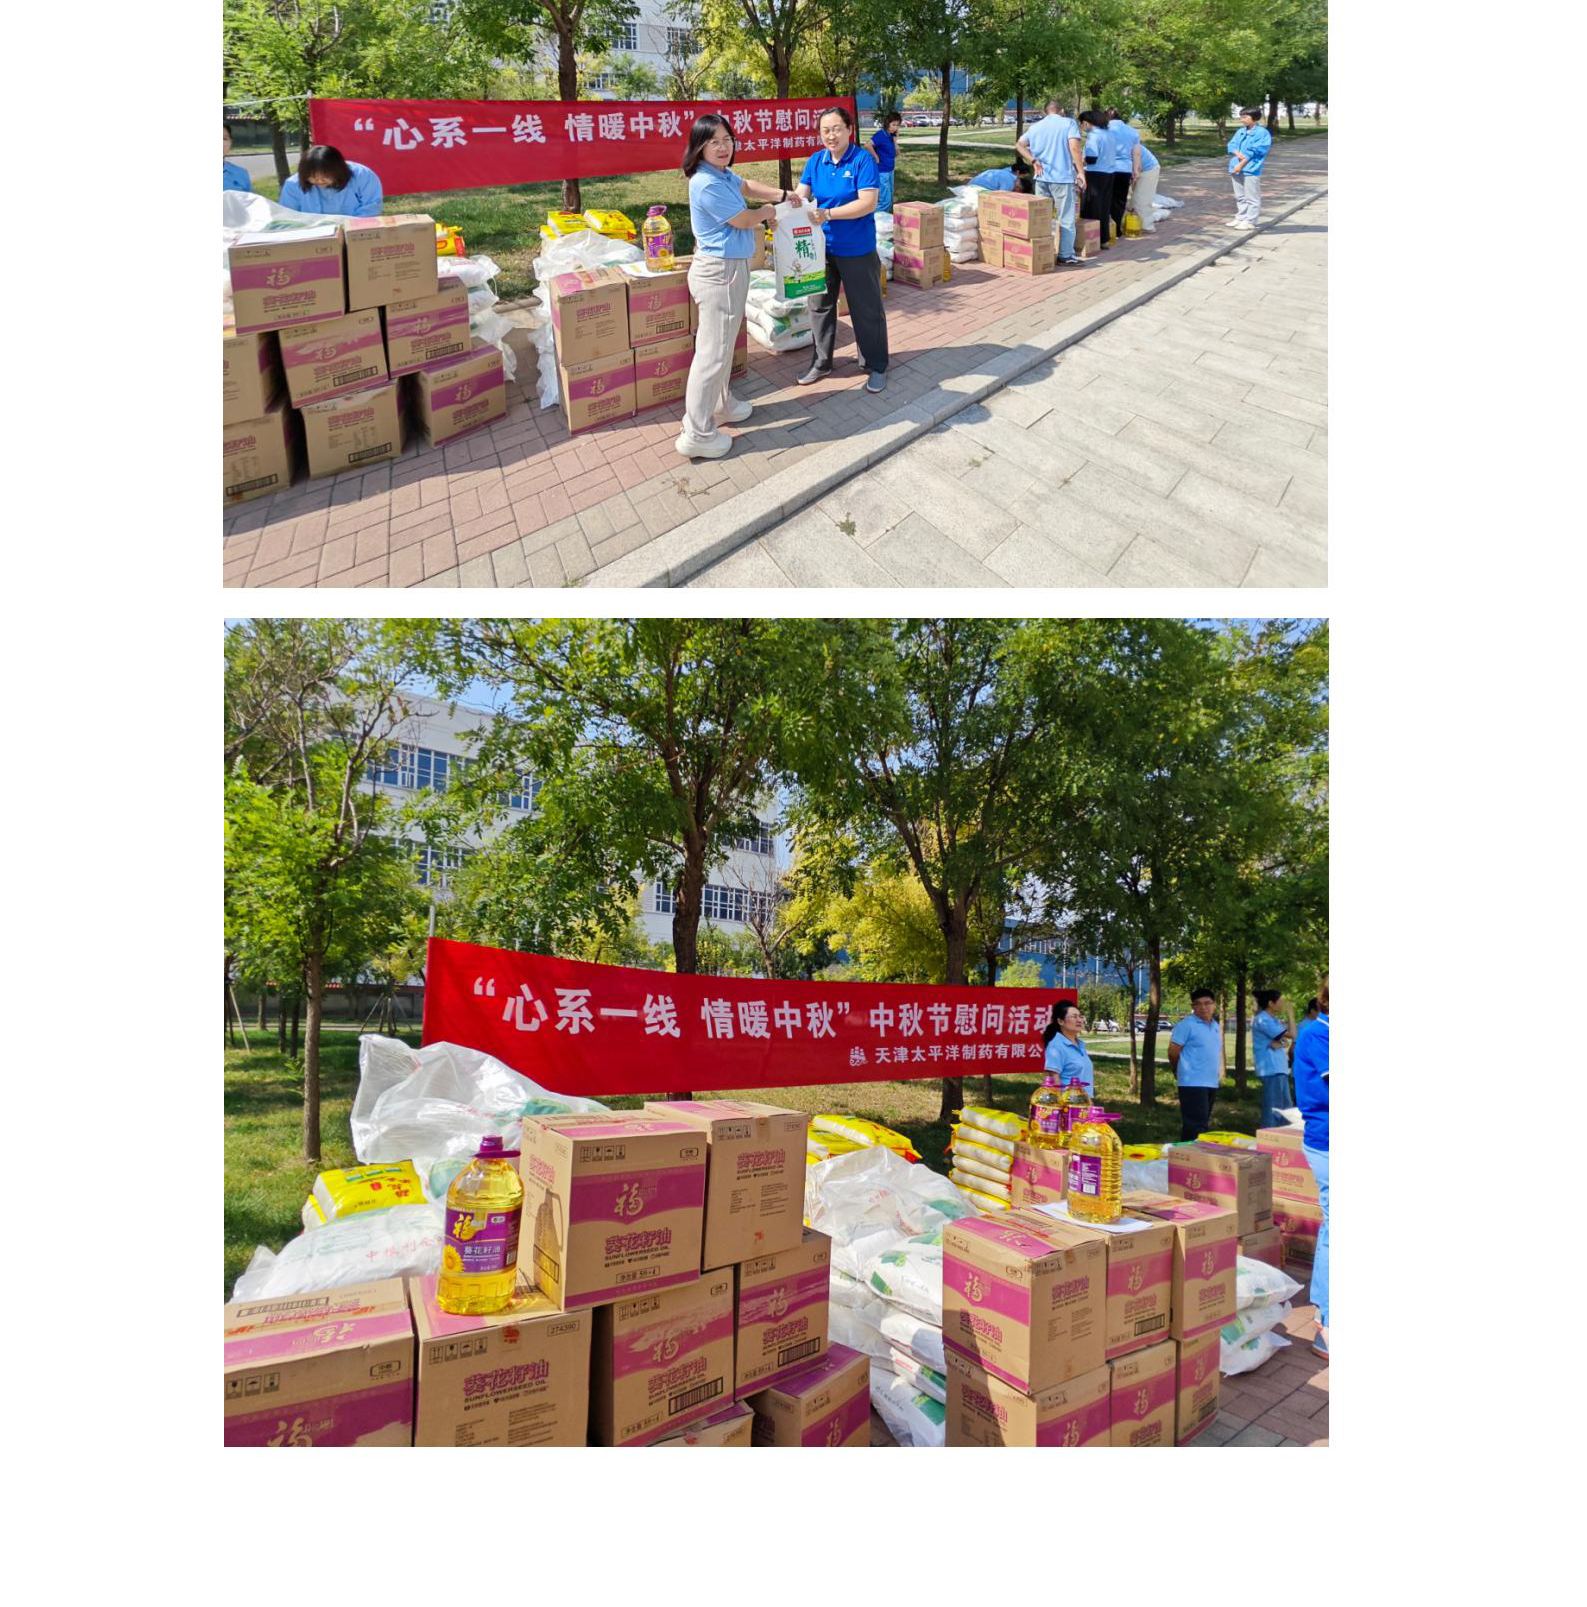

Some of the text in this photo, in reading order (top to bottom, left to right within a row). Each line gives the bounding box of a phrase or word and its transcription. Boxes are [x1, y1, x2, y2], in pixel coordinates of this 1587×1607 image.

[354, 114, 546, 150] “心系一线
[565, 110, 694, 142] 情暖中秋”
[473, 977, 681, 1038] “心系一线
[701, 997, 850, 1039] 情暖中秋”
[614, 1183, 644, 1217] 福
